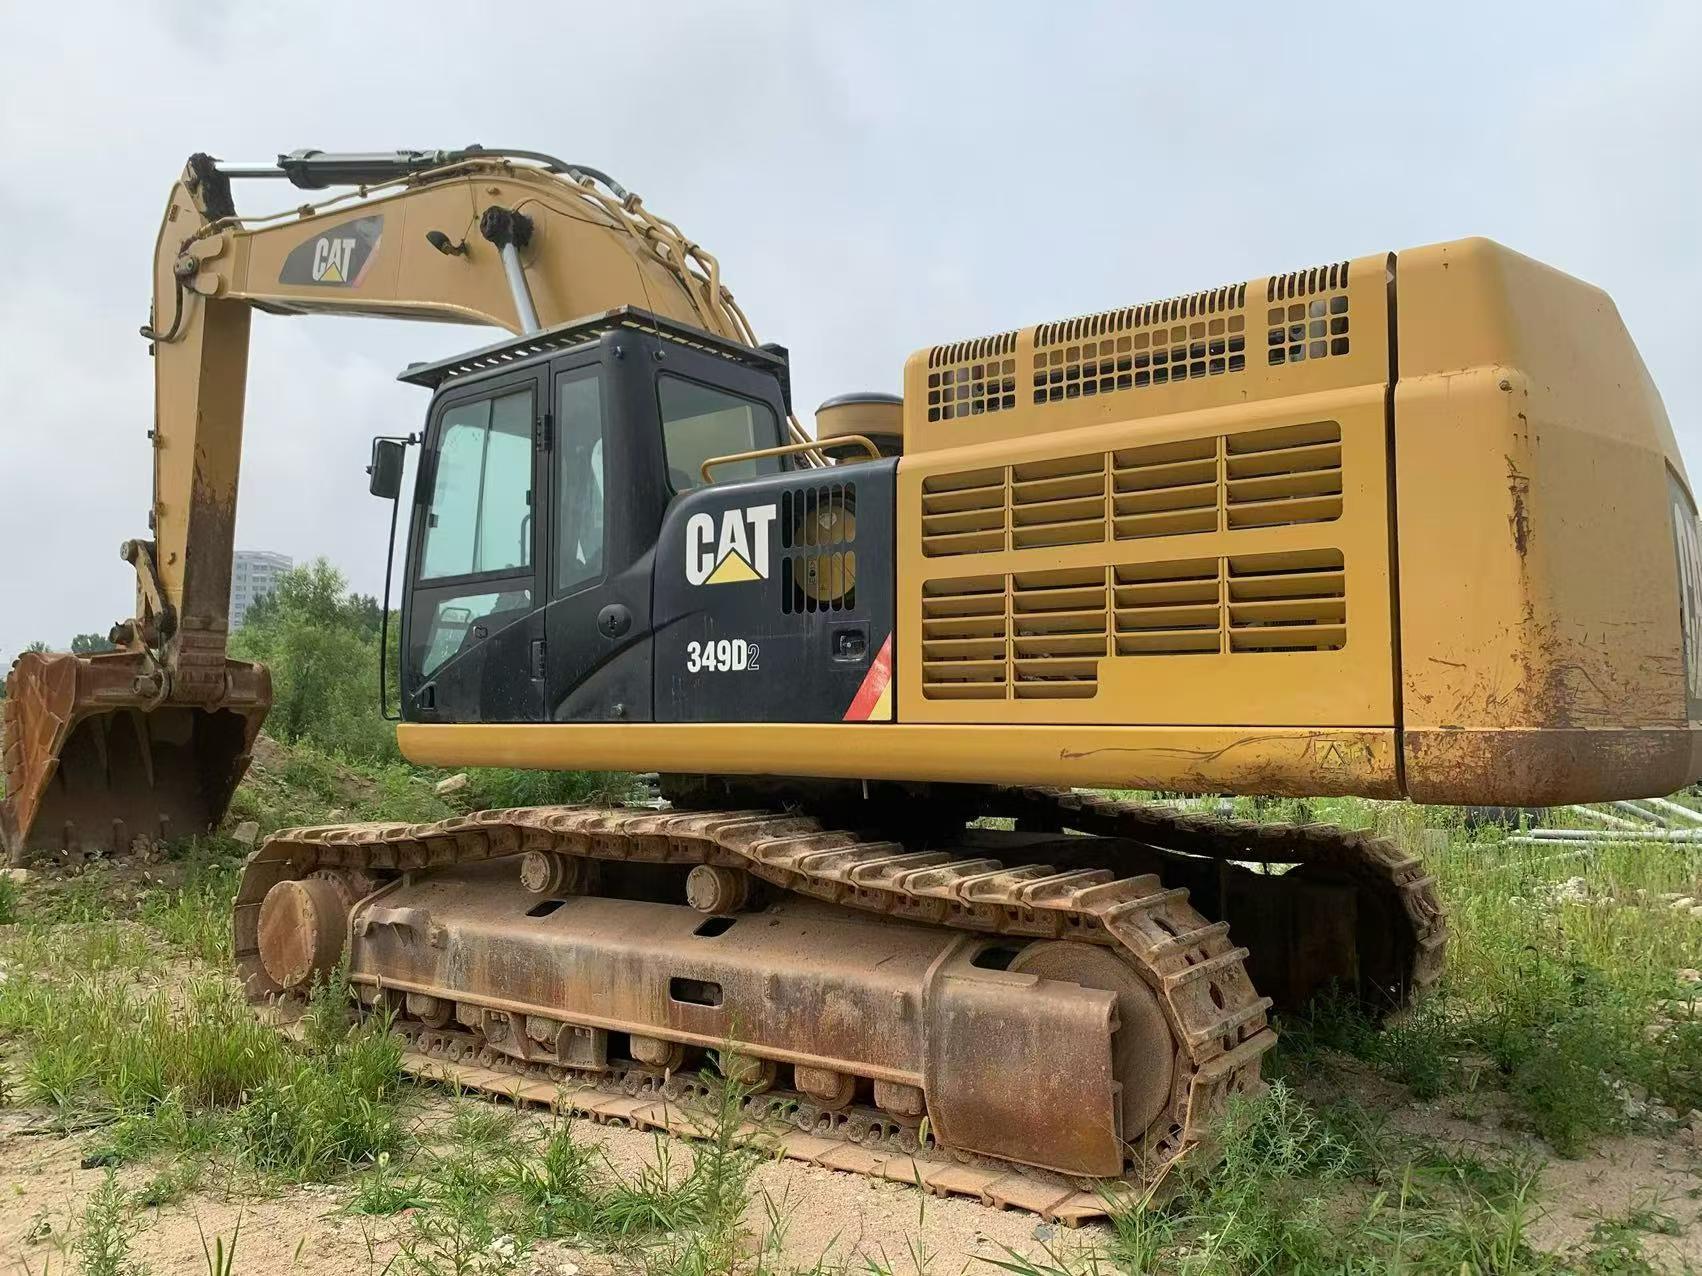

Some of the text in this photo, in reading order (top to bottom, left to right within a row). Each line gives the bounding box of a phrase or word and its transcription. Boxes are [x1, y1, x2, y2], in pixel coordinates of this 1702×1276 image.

[312, 237, 357, 283] CAT
[686, 504, 776, 586] CAT
[687, 639, 760, 673] 349D2
